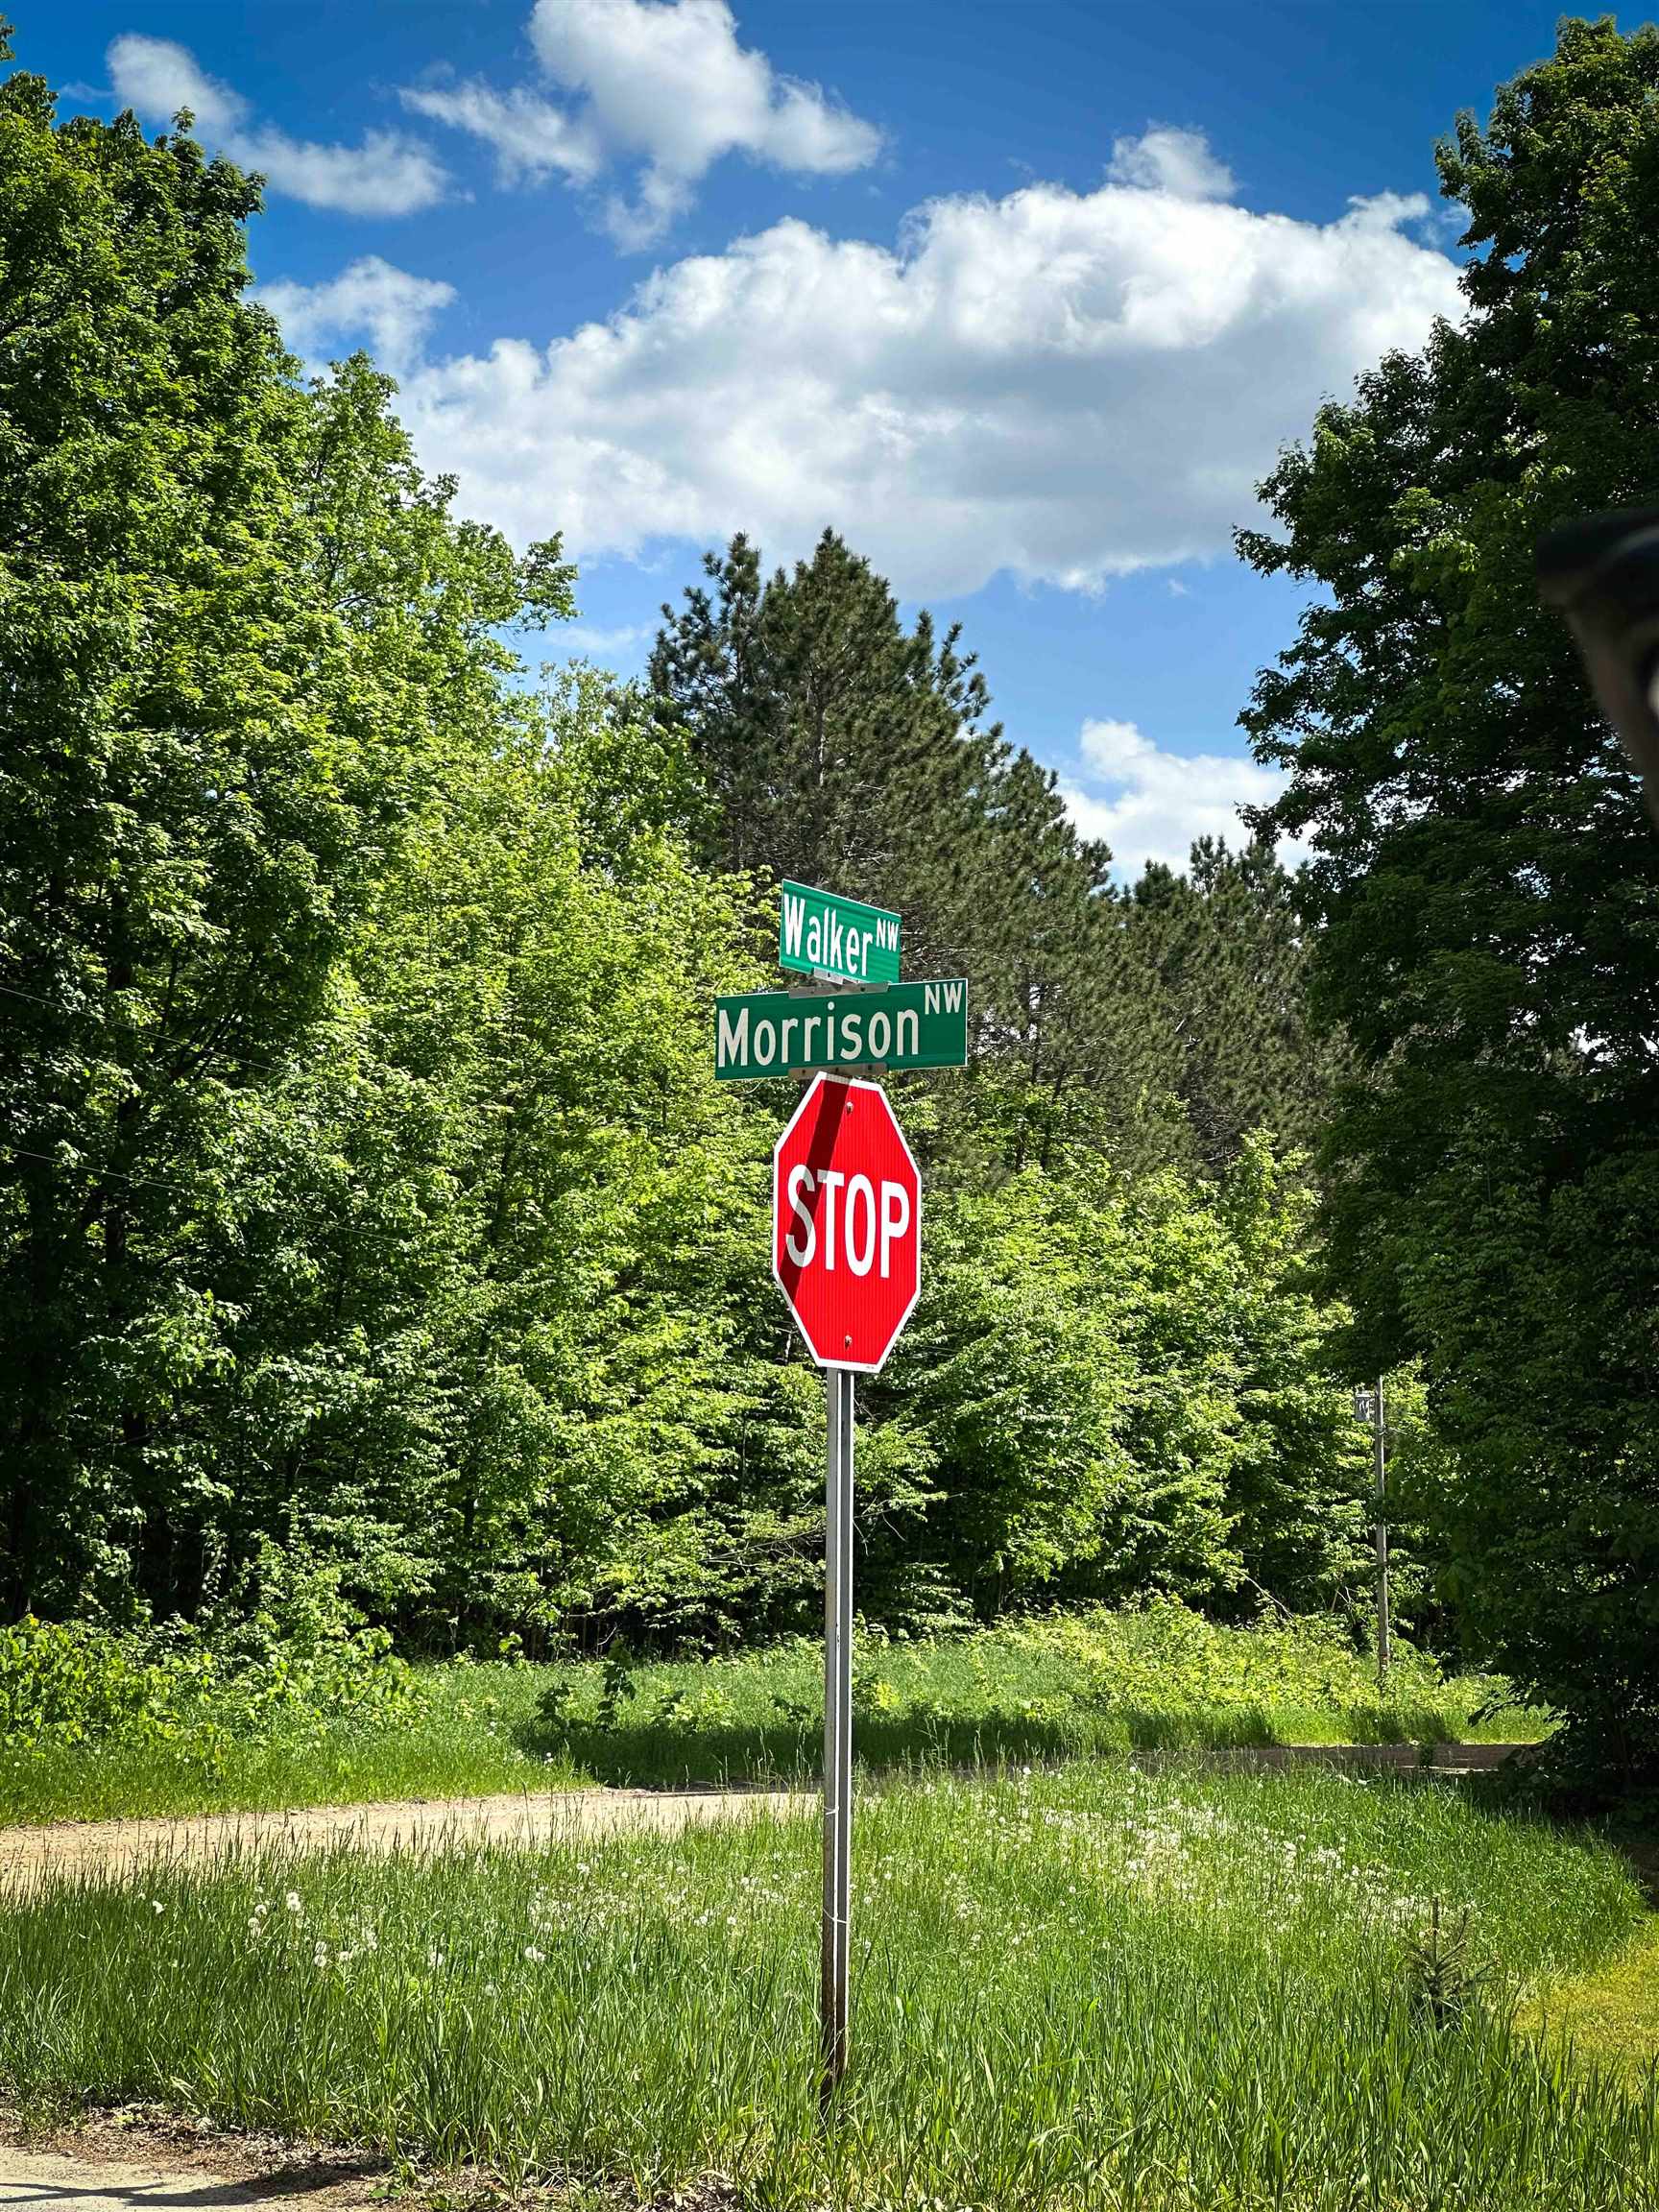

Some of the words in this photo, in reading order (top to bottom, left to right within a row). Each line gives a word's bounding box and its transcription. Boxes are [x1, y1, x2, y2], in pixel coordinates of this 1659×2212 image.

[783, 893, 874, 976] Walker
[876, 917, 900, 952] NW
[718, 1001, 919, 1068] Morrison
[925, 982, 963, 1015] NW
[785, 1164, 910, 1279] STOP
